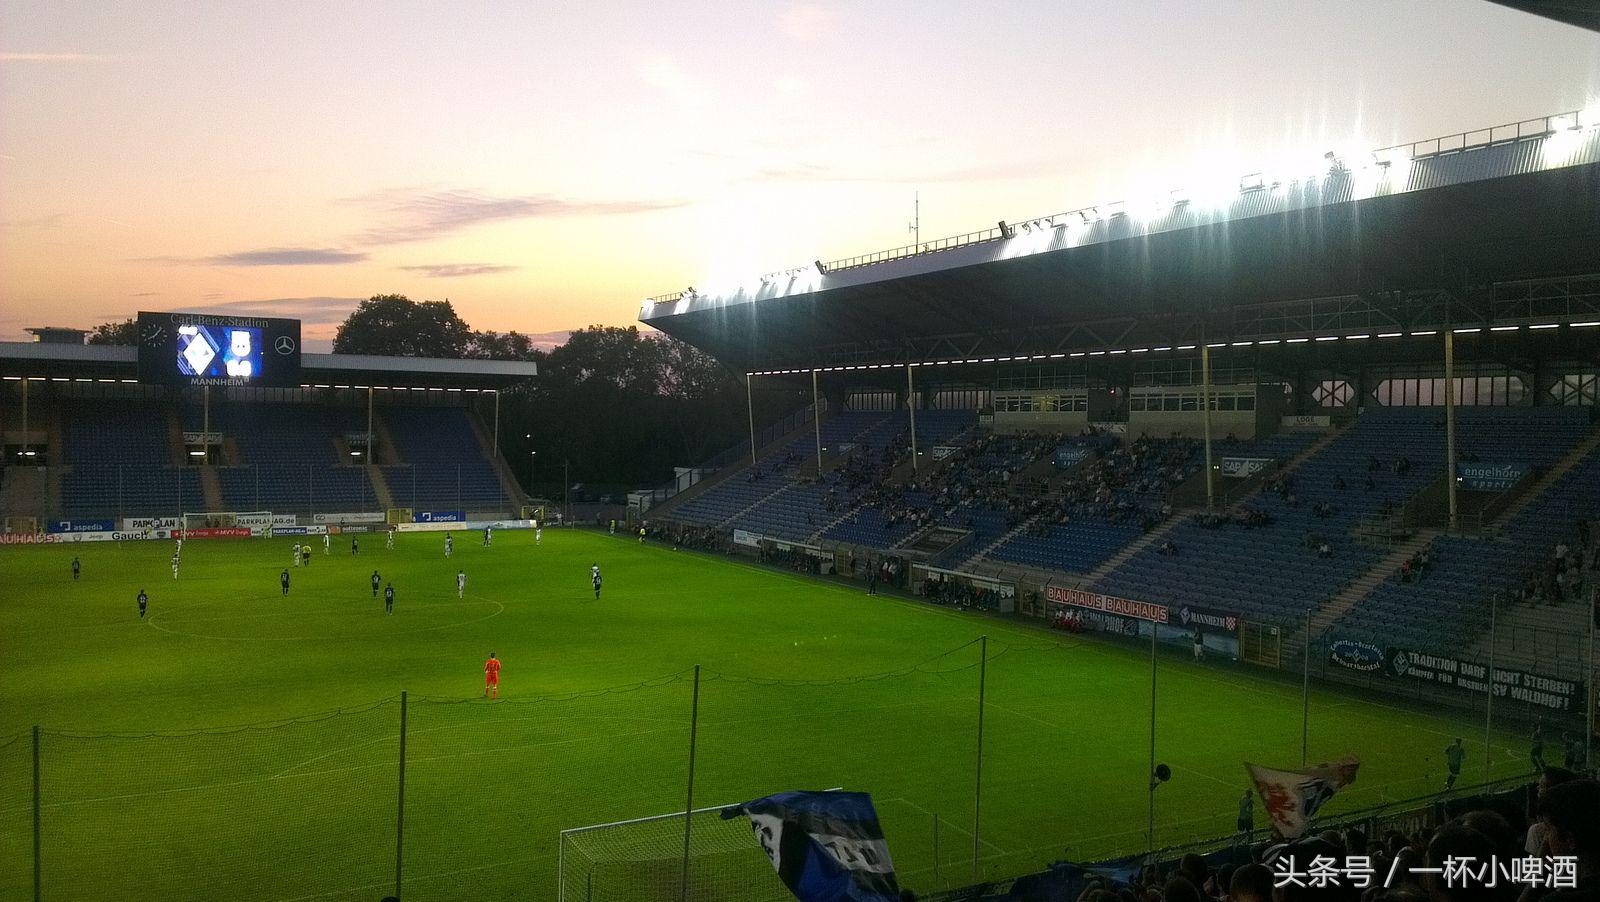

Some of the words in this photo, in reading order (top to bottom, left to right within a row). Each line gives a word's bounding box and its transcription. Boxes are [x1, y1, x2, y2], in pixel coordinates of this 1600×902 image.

[170, 313, 269, 328] Carl-Benz-Stadion
[190, 378, 244, 387] MANNHEIM
[73, 522, 103, 532] aspedia
[1047, 587, 1103, 607] BAUHAUS
[1106, 597, 1167, 621] BAUHAUS
[1190, 611, 1226, 628] MANNHEIM
[1408, 651, 1458, 673] TRADITION
[1461, 661, 1486, 678] DARF
[1524, 673, 1575, 695] STERBEN!
[1493, 683, 1508, 697] SV
[1510, 686, 1570, 710] WALDHOF!
